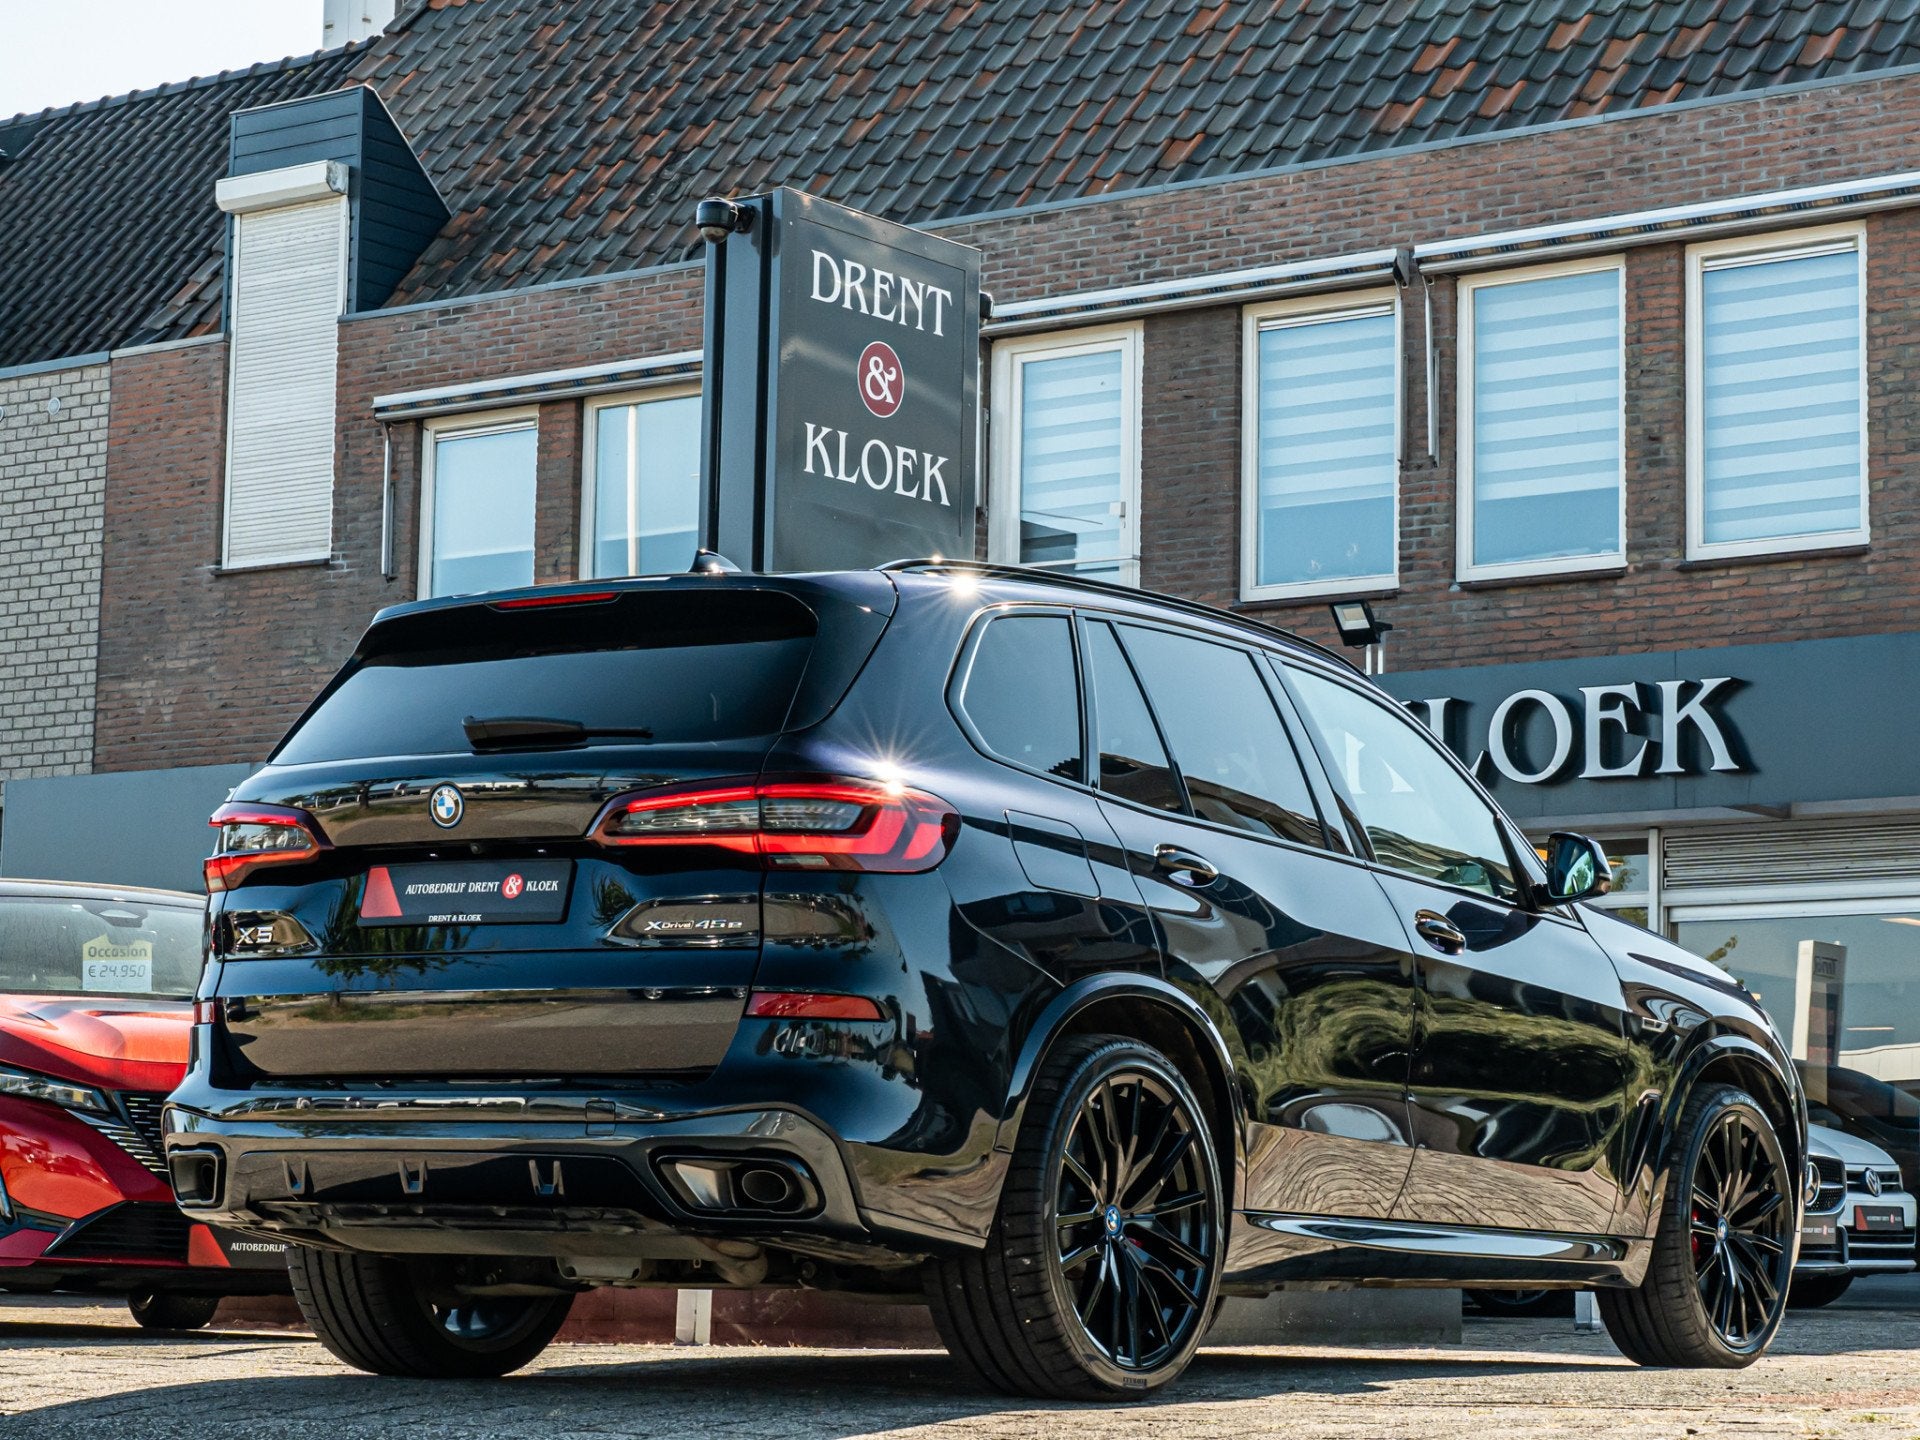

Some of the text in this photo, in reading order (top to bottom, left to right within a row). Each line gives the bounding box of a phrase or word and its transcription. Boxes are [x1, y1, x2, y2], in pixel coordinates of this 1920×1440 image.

[811, 250, 952, 336] DRENT
[865, 356, 896, 404] &
[804, 422, 950, 506] KLOEK
[405, 876, 559, 895] AUTOBEDRIJF DRENT & KLOEK
[428, 914, 452, 922] DRENT
[458, 914, 482, 922] KLOEK
[237, 926, 273, 944] X5
[88, 946, 147, 958] Occasion
